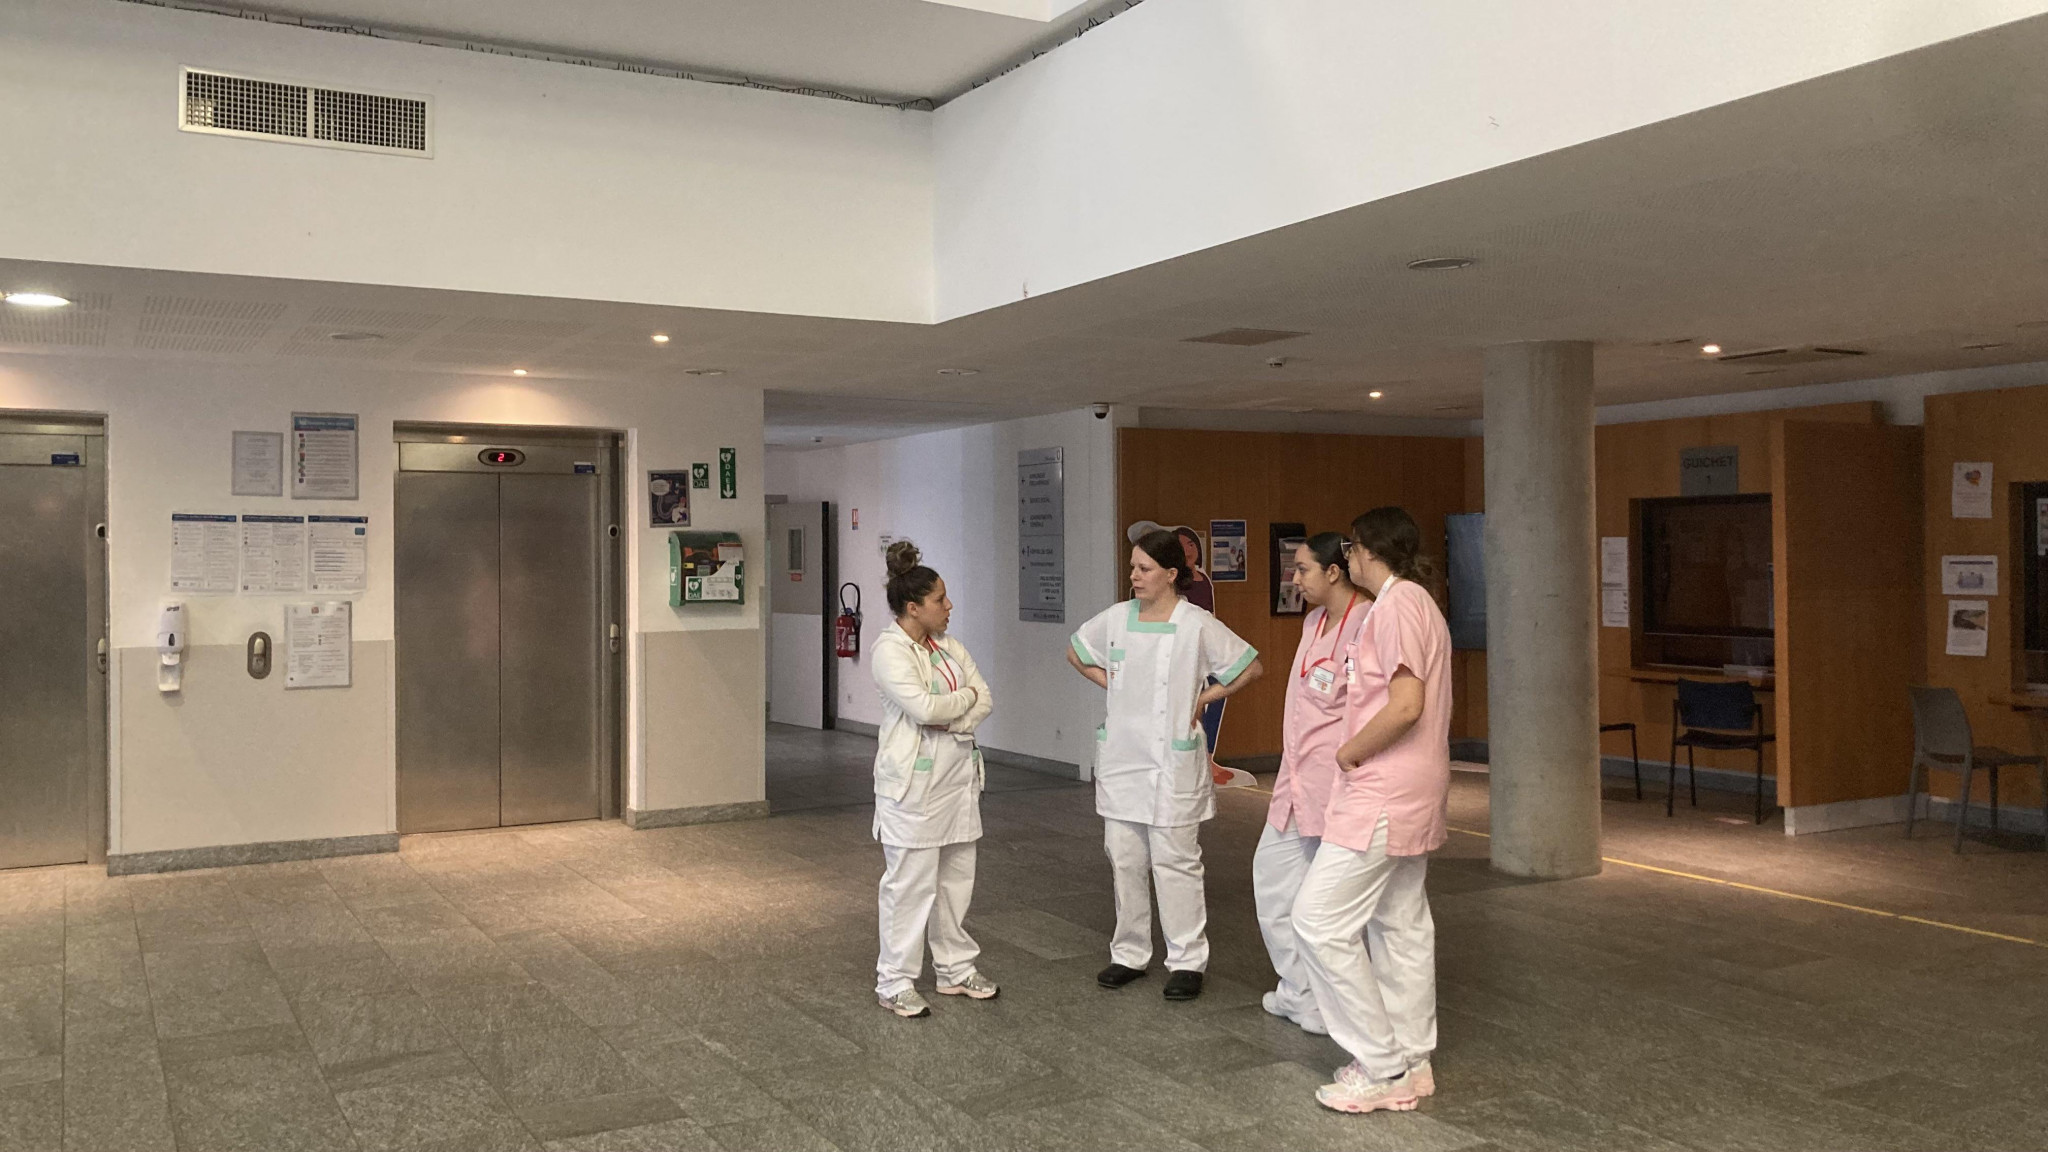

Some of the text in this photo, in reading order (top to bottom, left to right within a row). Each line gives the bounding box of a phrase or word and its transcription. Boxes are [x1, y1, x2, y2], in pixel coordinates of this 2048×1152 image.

[497, 453, 505, 462] 2
[1683, 456, 1733, 468] GUICHET
[693, 480, 708, 488] DAE
